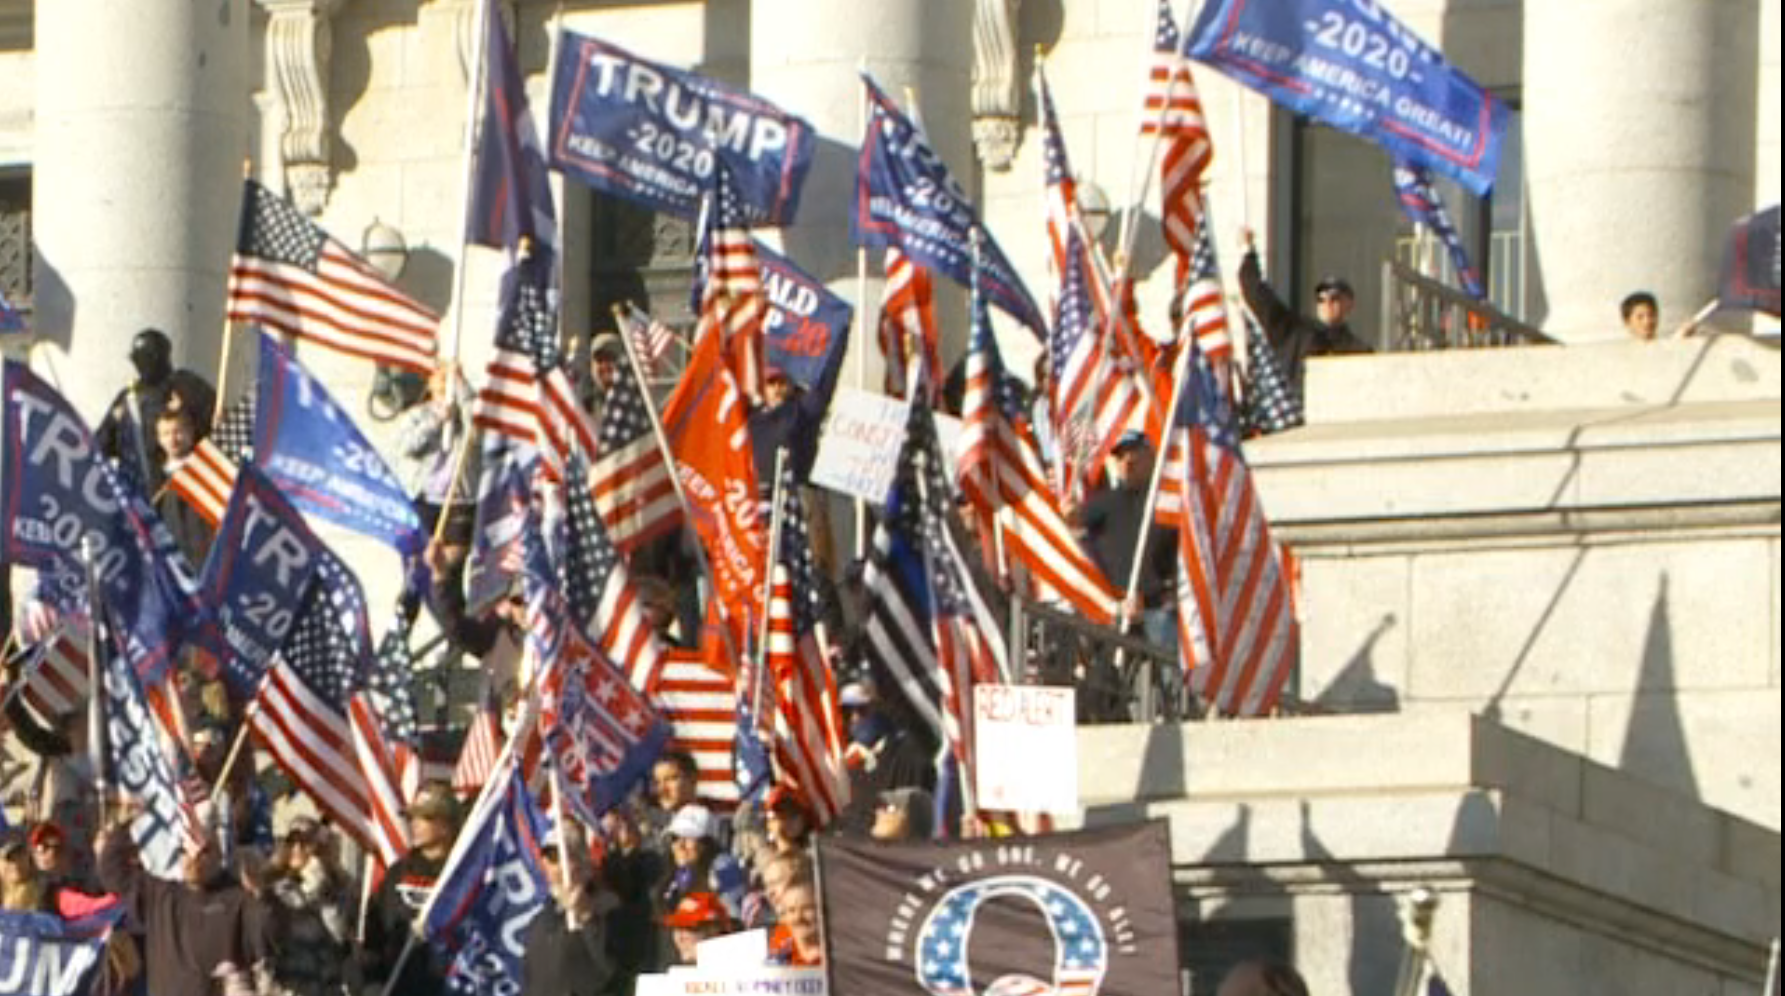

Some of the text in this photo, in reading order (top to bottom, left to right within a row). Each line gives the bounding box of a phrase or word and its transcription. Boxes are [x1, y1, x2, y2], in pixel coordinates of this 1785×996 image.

[1233, 31, 1290, 61] KEEP
[1293, 53, 1390, 105] AMERICA
[591, 53, 787, 161] TRUMP
[569, 133, 697, 196] KEEP AMERICA
